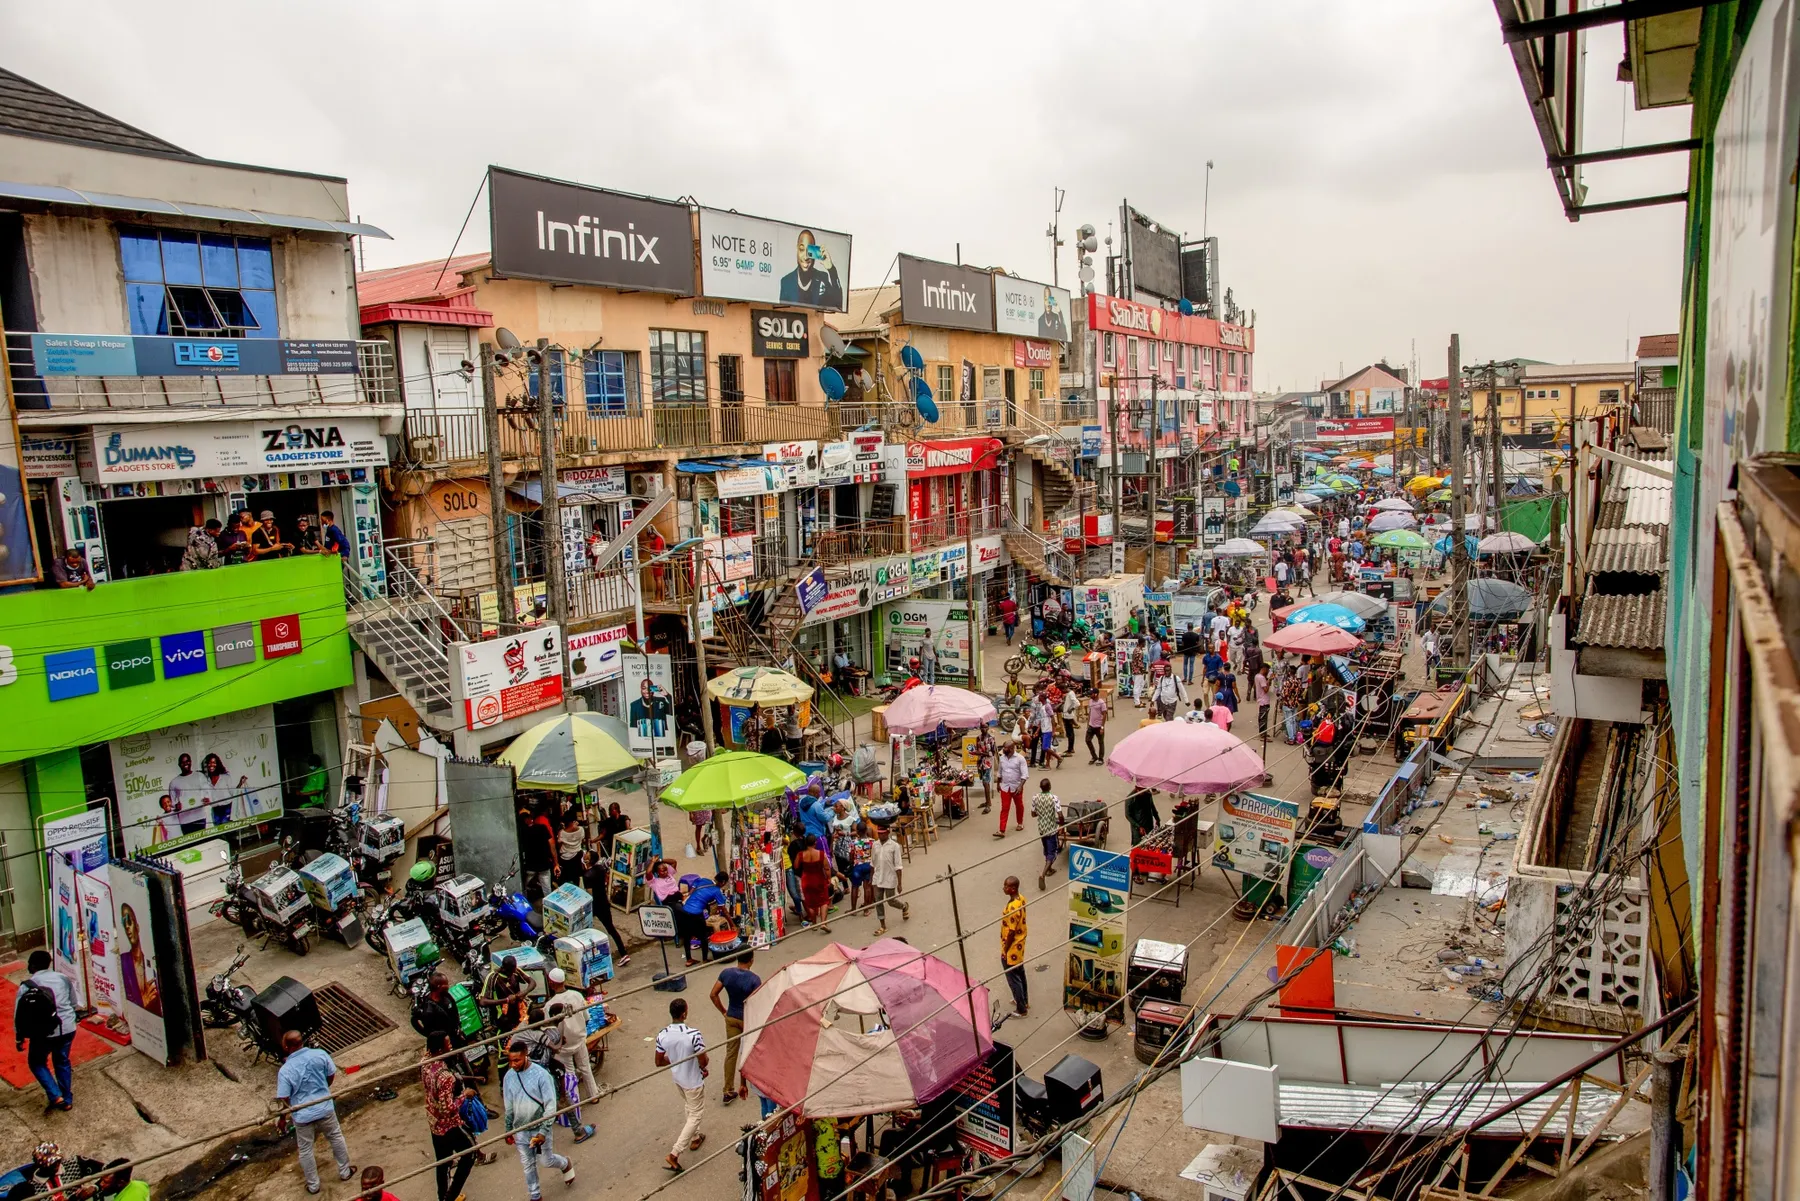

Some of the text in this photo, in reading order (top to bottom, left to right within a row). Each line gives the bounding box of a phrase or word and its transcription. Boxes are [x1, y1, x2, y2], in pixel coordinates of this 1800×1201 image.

[537, 210, 661, 265] Infinix
[712, 233, 772, 257] NOTE 8 8i
[713, 256, 772, 274] 6.95" 64MP G80
[922, 279, 977, 314] Infinix
[1005, 292, 1022, 306] NOTE
[1109, 300, 1150, 332] SanDisk
[1219, 324, 1244, 347] SanDisk
[45, 339, 127, 349] Sales Swap Repair
[765, 341, 801, 351] SERVICE CENTRE
[261, 425, 346, 452] ZONA
[265, 450, 344, 462] GADGETSTORE
[110, 463, 175, 472] GADGETS STORE
[572, 467, 609, 481] DOZAK
[443, 491, 478, 512] SOLO
[1180, 504, 1188, 535] Infinix
[853, 568, 871, 584] CELL
[888, 561, 909, 579] OGM
[903, 612, 928, 623] OGM
[588, 631, 612, 647] LINKS
[612, 627, 627, 640] LTD
[216, 638, 254, 653] oraimo
[165, 647, 204, 663] vivo
[49, 666, 96, 682] NOKIA
[505, 682, 535, 694] LAPTOPS
[120, 744, 151, 757] Banana
[124, 755, 155, 768] Lifestyle
[531, 768, 568, 778] Infinix
[124, 775, 163, 797] 50% OFF
[740, 777, 770, 790] oraimo
[744, 790, 777, 804] Protector
[1241, 798, 1294, 822] PARAGONS
[1271, 818, 1292, 829] LIMITED
[47, 826, 67, 836] OPPO
[47, 834, 67, 842] Picture
[157, 839, 178, 853] GOOD
[178, 832, 202, 847] QUALITY
[223, 821, 241, 833] CHEAP
[1076, 849, 1093, 873] hp
[1307, 853, 1334, 864] imose
[438, 863, 454, 875] SPOT
[643, 919, 674, 929] NO PARKING
